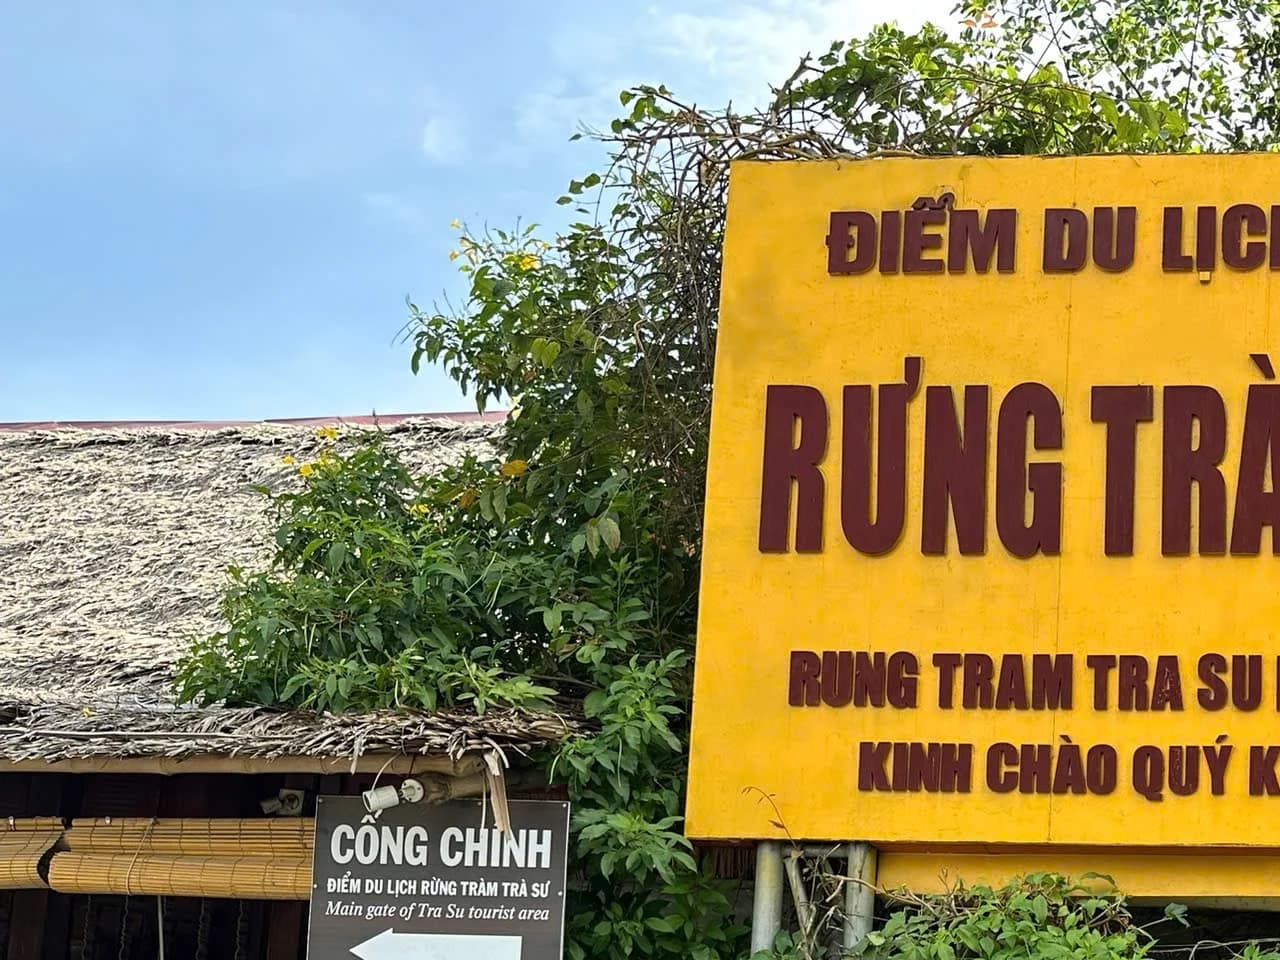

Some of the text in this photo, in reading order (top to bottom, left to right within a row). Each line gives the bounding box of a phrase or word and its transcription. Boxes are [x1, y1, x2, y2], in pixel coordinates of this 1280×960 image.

[1043, 206, 1137, 274] DU
[758, 356, 1063, 560] RƯNG
[788, 650, 920, 710] RUNG
[932, 653, 1074, 711] TRAM
[1086, 654, 1184, 712] TRA
[1197, 653, 1263, 713] SU
[857, 741, 973, 794] KINH
[986, 734, 1118, 796] CHÀO
[1132, 734, 1233, 802] QUÝ
[325, 901, 550, 921] Main gate of Tra Su tourist area
[327, 871, 551, 898] ĐIỂM DU LỊCH RỪNG TRÀM TRÀ SƯ
